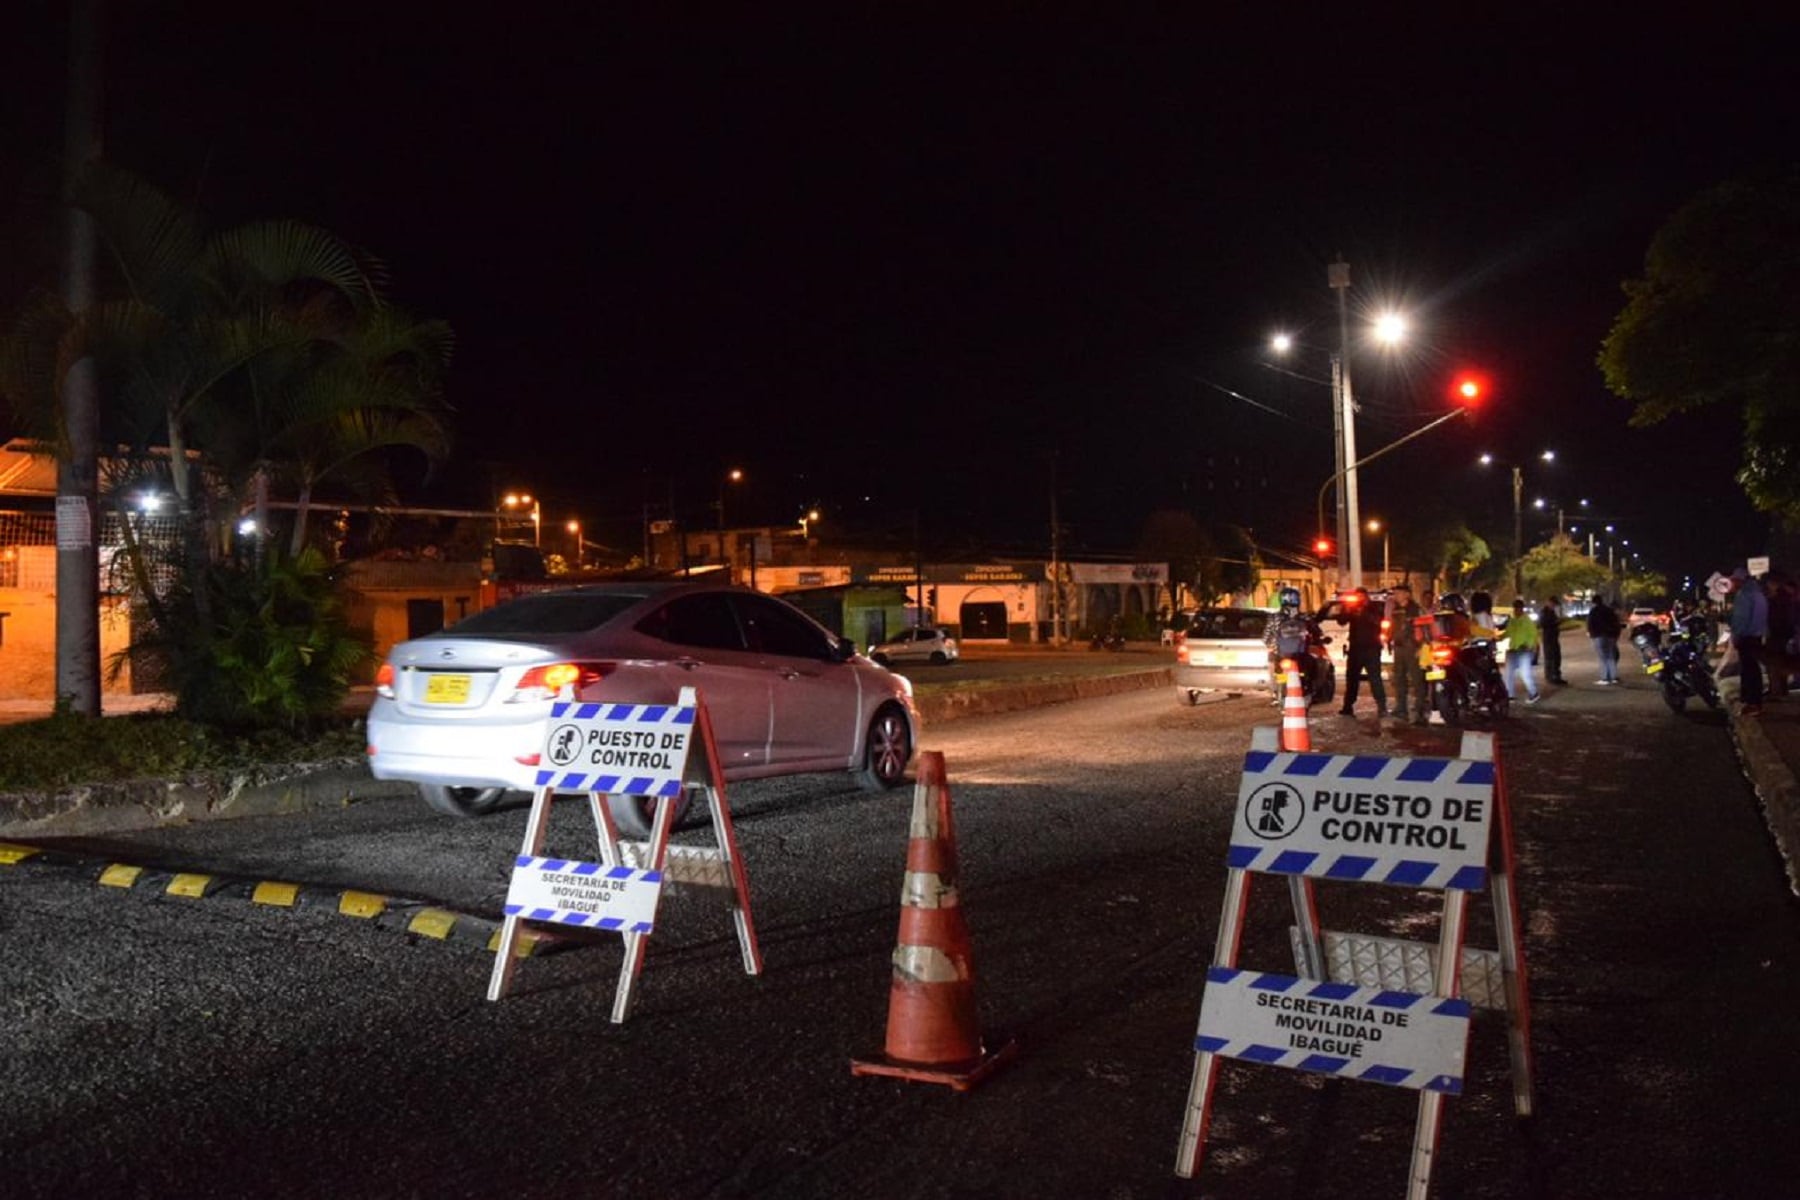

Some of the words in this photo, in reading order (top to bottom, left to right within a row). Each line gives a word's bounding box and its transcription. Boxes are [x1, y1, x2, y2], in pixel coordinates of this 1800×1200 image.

[588, 730, 655, 748] PUESTO
[661, 733, 685, 750] DE
[591, 749, 672, 769] CONTROL
[1312, 790, 1432, 819] PUESTO
[1442, 798, 1484, 822] DE
[1321, 818, 1466, 850] CONTROL
[542, 873, 609, 889] SECRETARIA
[611, 881, 626, 891] DE
[551, 886, 611, 902] MOVILIDAD
[1257, 993, 1375, 1023] SECRETARIA
[1382, 1011, 1409, 1028] DE
[1276, 1014, 1382, 1042] MOVILIDAD
